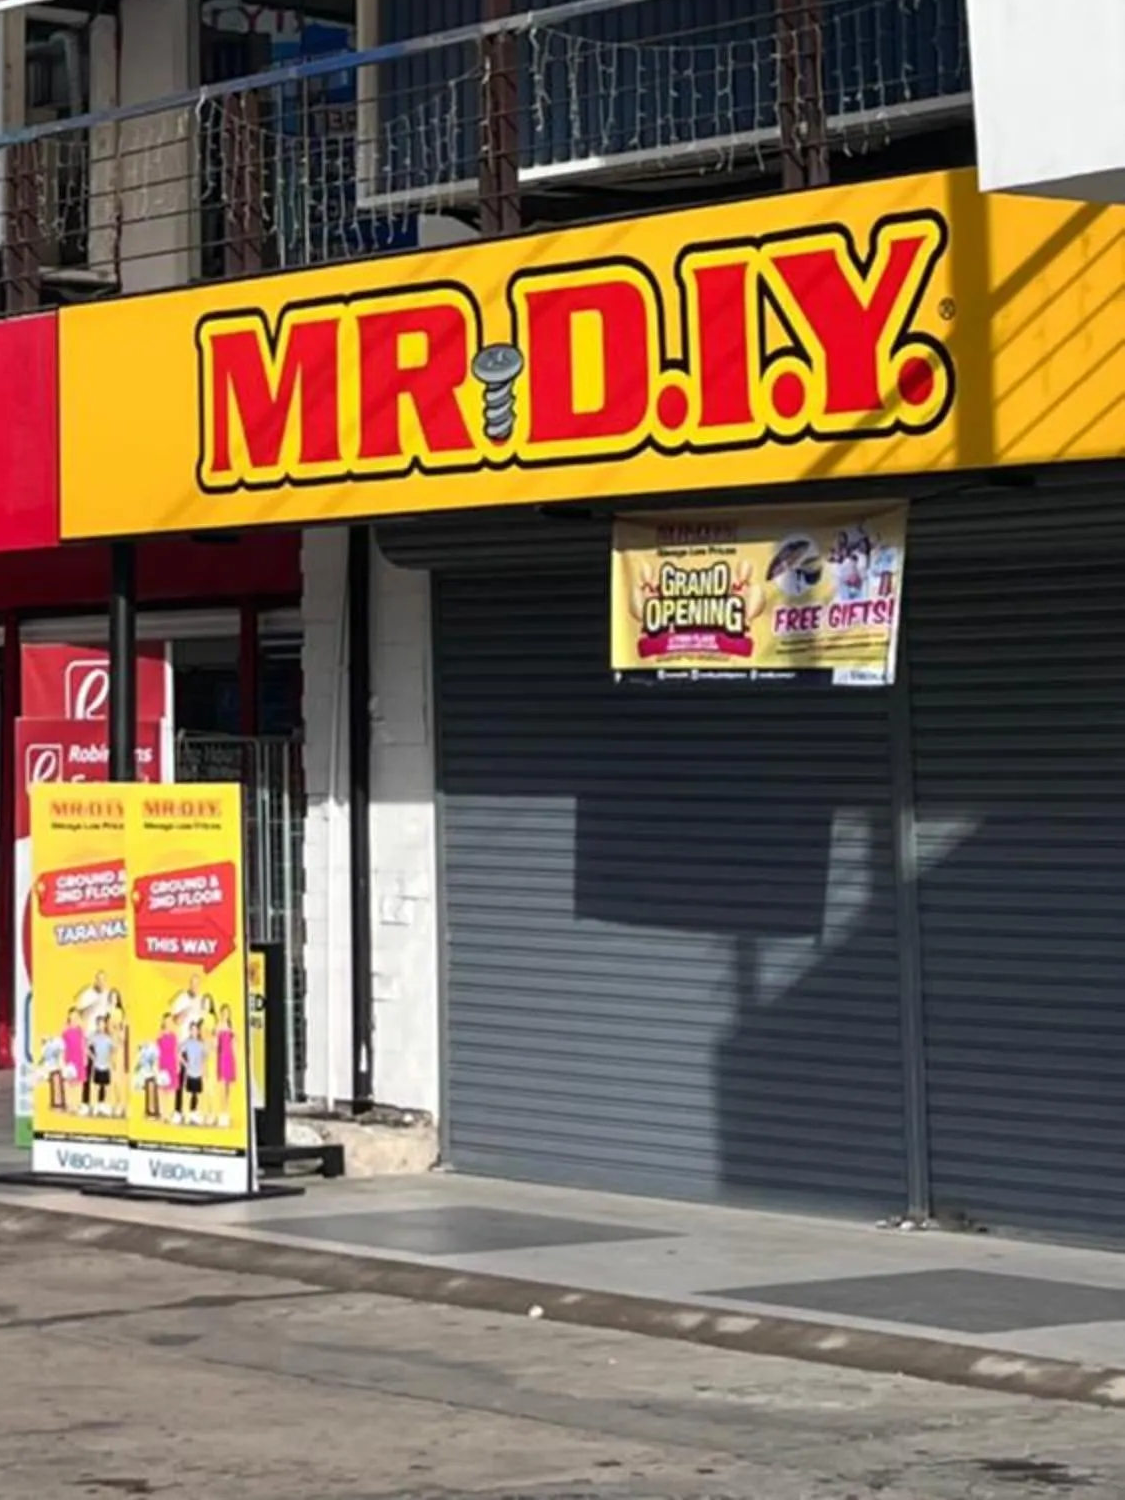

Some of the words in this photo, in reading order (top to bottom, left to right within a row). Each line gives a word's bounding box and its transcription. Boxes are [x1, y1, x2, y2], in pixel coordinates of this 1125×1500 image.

[661, 563, 729, 596] GRAND
[644, 597, 745, 632] OPENING
[775, 605, 821, 632] FREE
[828, 599, 894, 628] GIFTS!
[56, 871, 117, 889] GROUND
[150, 877, 207, 894] GROUND
[178, 889, 223, 907] FLOOR
[55, 922, 99, 944] TARA
[146, 936, 179, 952] THIS
[181, 939, 218, 954] WAY
